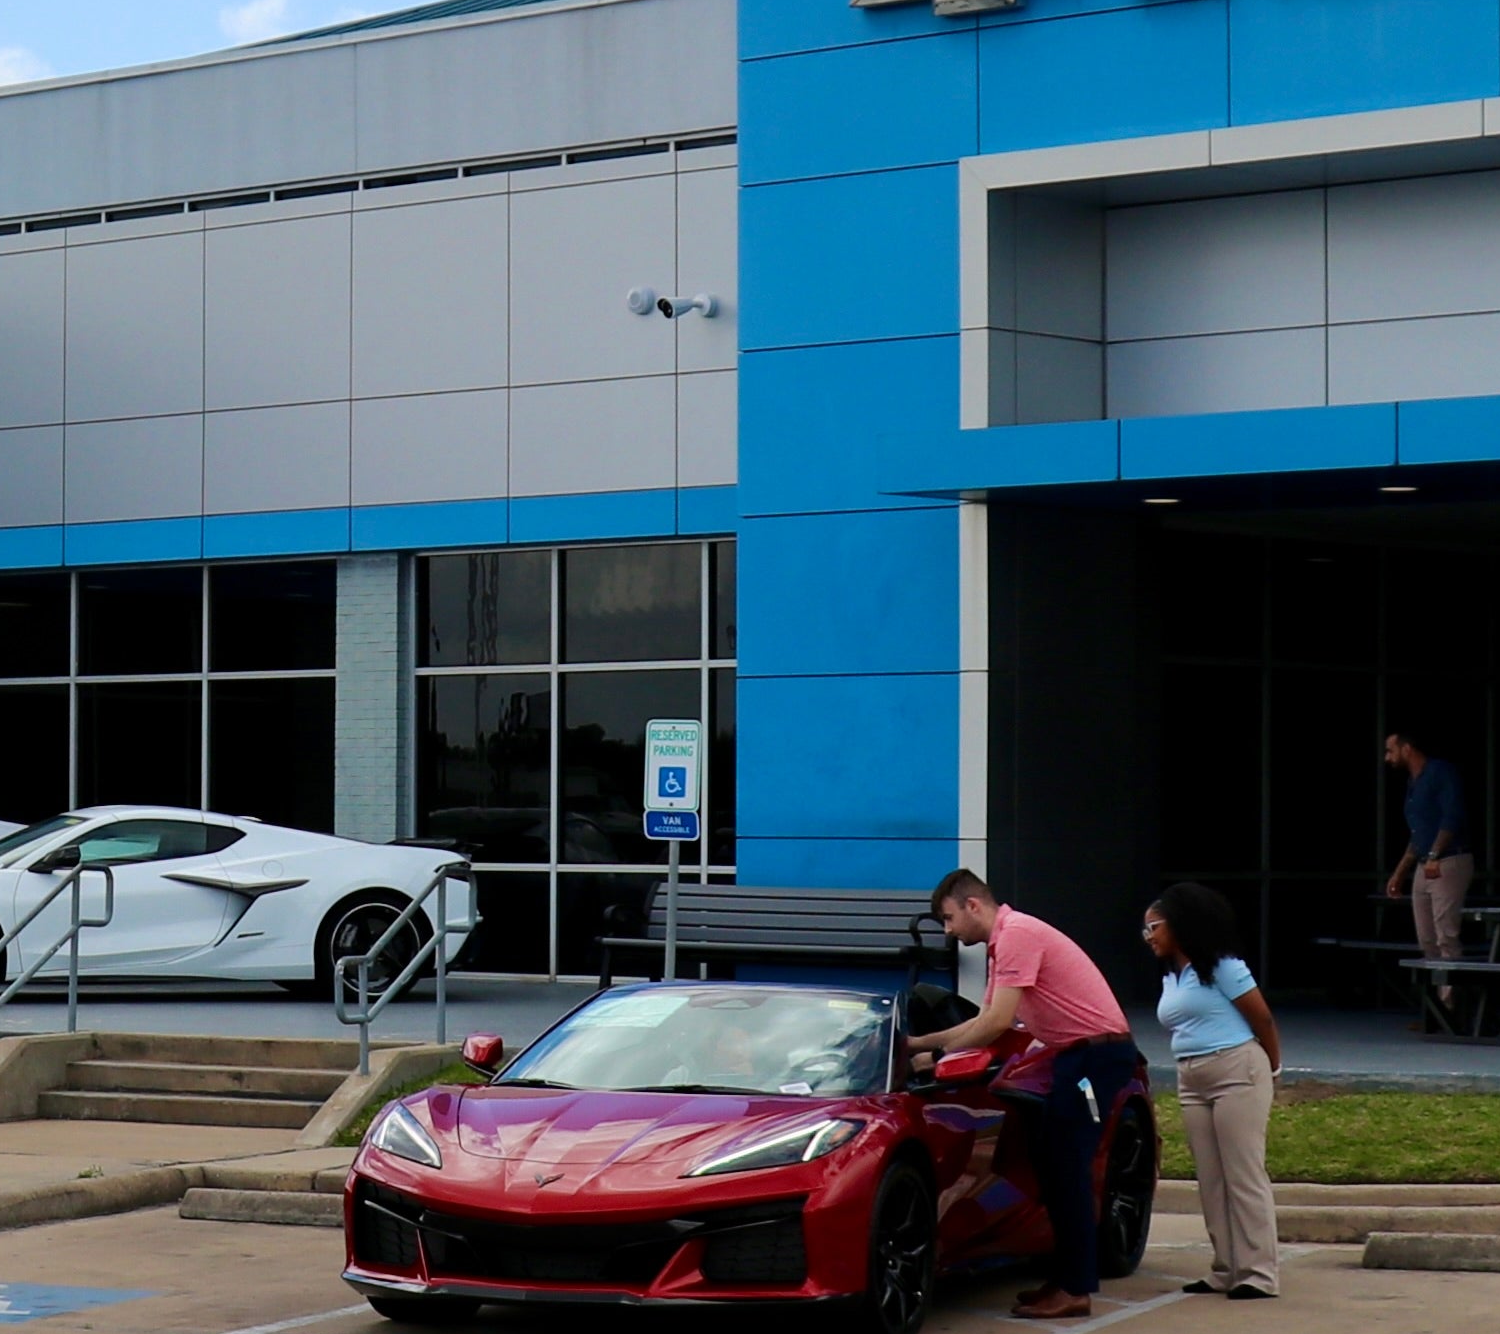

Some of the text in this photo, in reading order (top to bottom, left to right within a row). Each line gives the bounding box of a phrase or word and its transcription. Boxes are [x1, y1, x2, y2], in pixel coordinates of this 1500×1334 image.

[650, 729, 697, 741] RESERVED
[653, 745, 694, 757] PARKING
[662, 816, 682, 825] VAN
[653, 826, 690, 834] ACCESSIBLE
